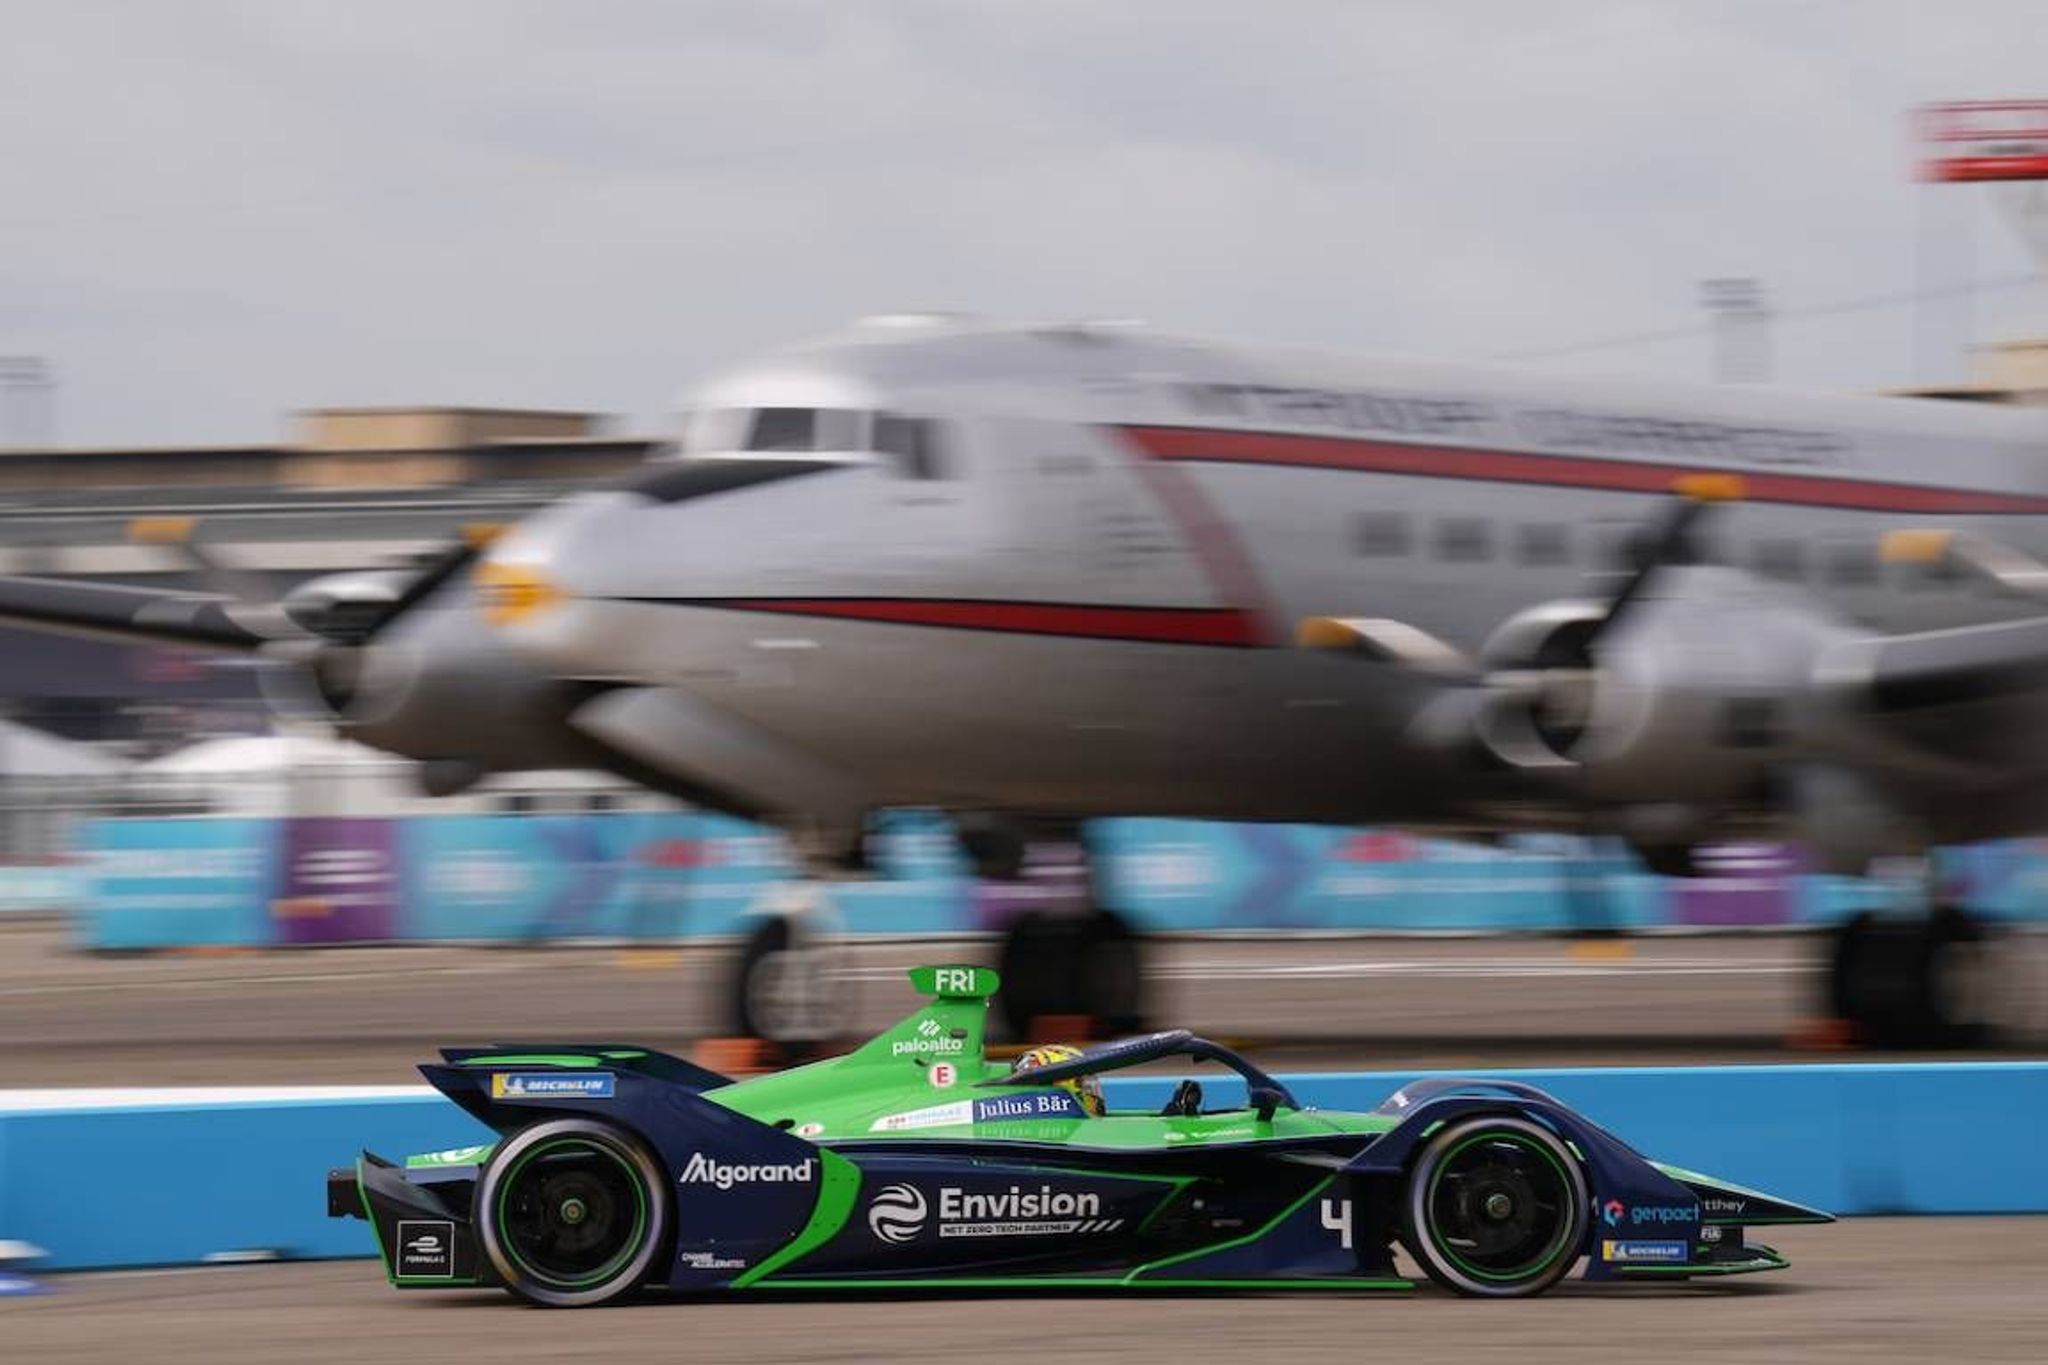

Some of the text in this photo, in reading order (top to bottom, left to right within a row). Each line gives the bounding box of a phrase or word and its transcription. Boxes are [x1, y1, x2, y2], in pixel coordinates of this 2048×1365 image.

[935, 969, 975, 992] FRI
[893, 1036, 963, 1056] paloalto
[527, 1080, 604, 1090] MICHELIN
[936, 1066, 949, 1083] E
[979, 1102, 1032, 1119] Julius
[1037, 1096, 1071, 1112] Bär
[680, 1152, 812, 1190] Algorand
[939, 1186, 1100, 1219] Envision
[1702, 1199, 1746, 1213] tthey
[1320, 1199, 1352, 1249] 4
[1631, 1203, 1699, 1225] genpact
[943, 1223, 1072, 1235] NET ZERO TECH PARTNER
